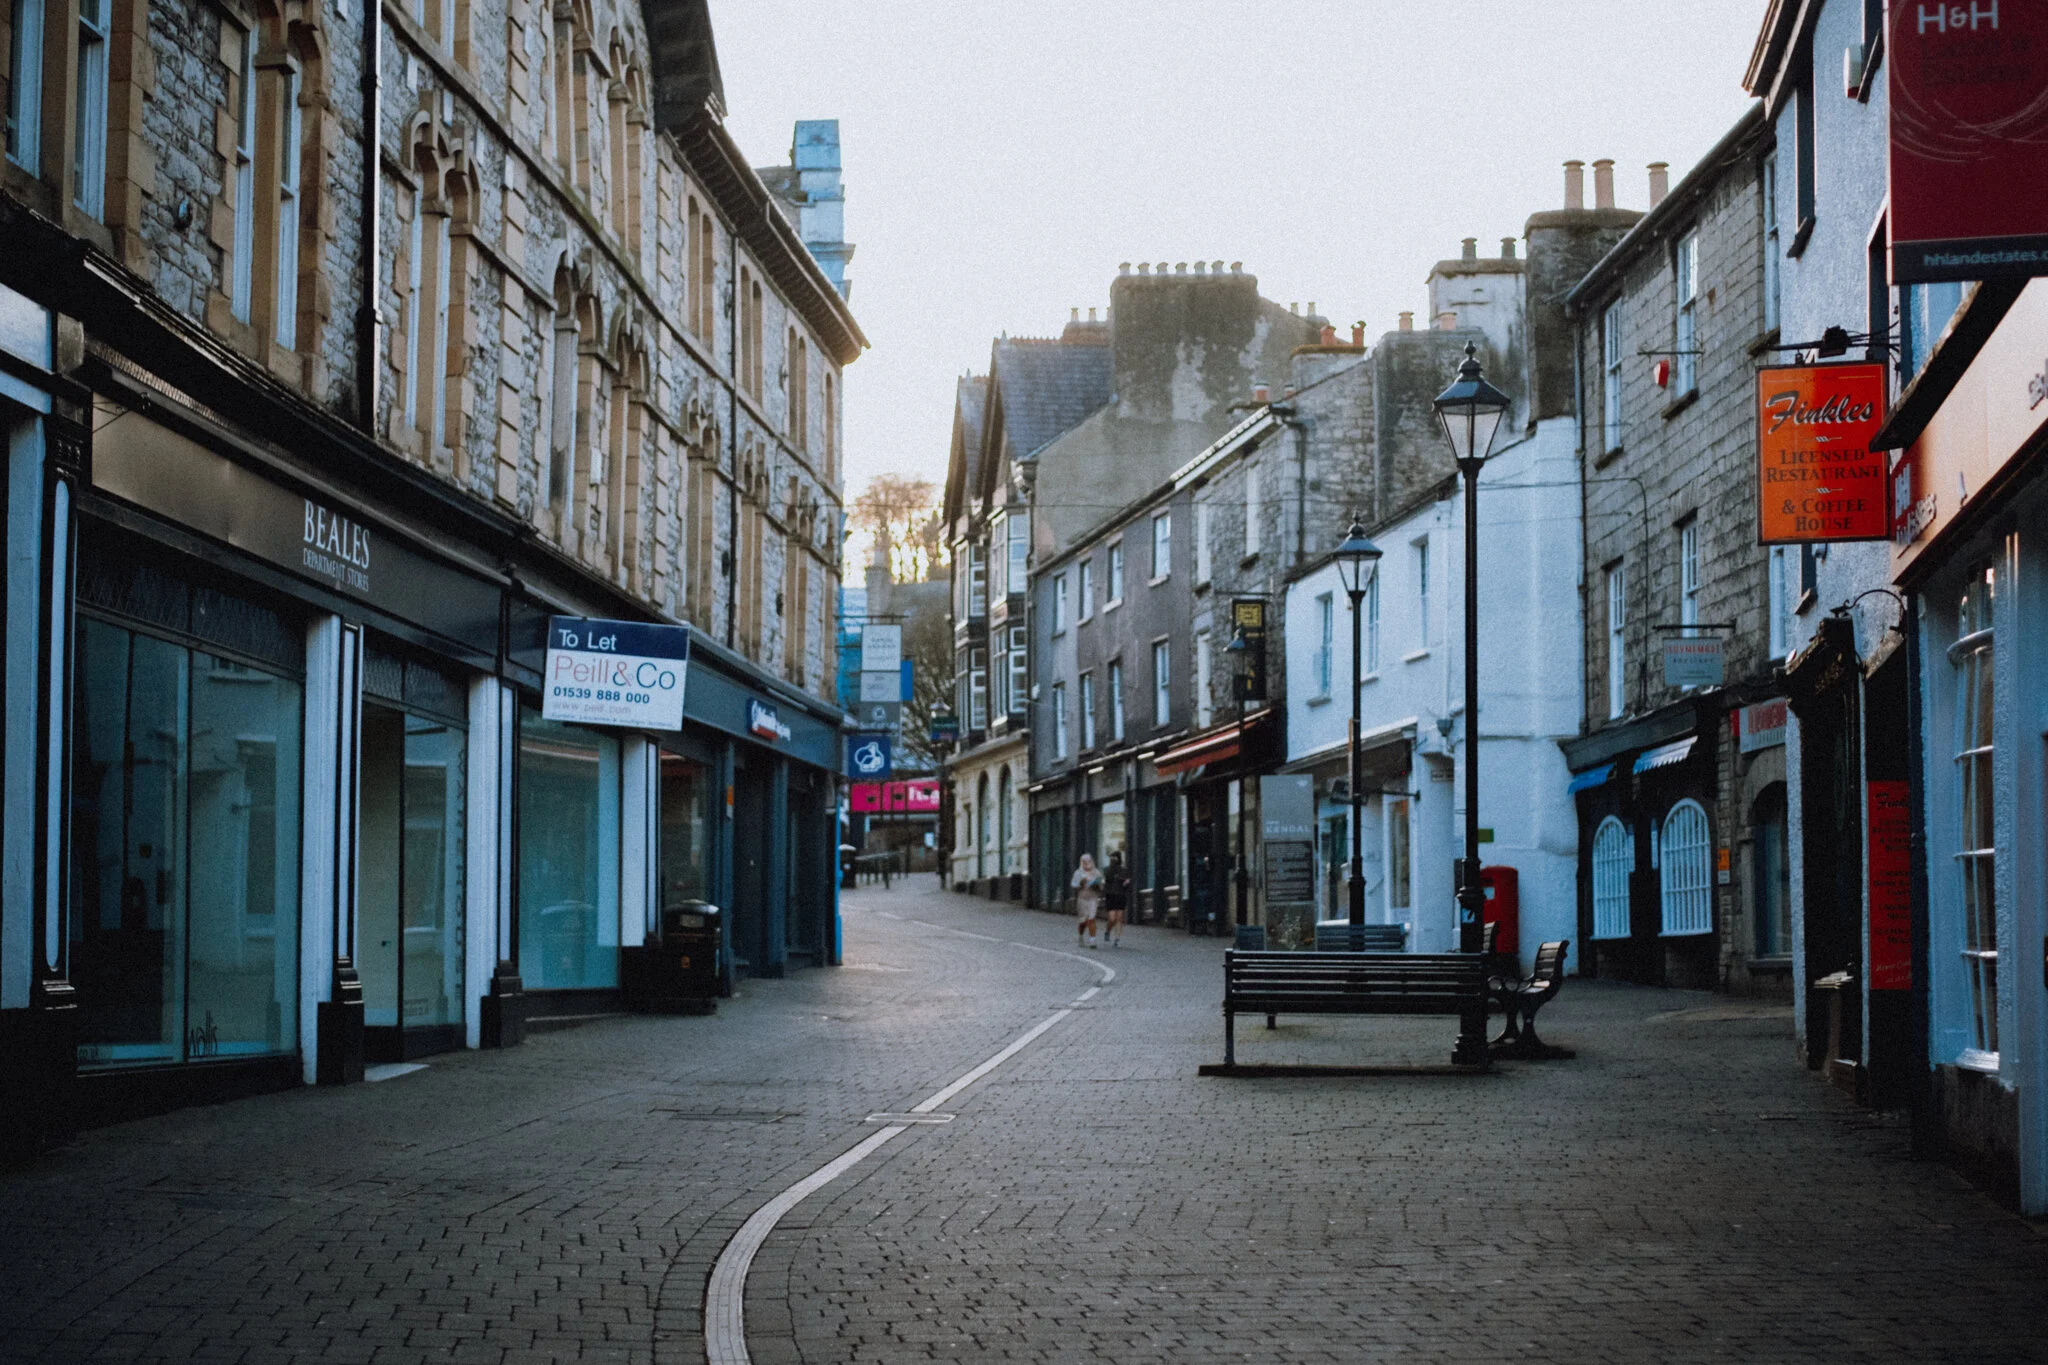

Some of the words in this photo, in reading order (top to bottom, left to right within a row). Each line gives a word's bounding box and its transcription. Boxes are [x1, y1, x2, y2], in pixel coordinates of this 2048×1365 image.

[1917, 0, 1999, 34] H&H
[1765, 389, 1874, 435] Finkles
[1780, 447, 1865, 465] LICENSED
[1766, 465, 1880, 483] RESTAURANT
[1782, 498, 1795, 515] &
[1802, 497, 1867, 514] COFFEE
[1795, 516, 1853, 532] HOUSE
[303, 498, 370, 569] BEALES
[303, 547, 346, 582] DEPARTMENT
[558, 628, 579, 648] To
[587, 631, 618, 651] Let
[553, 686, 592, 699] 01539
[596, 689, 621, 701] 888
[626, 692, 650, 704] 000
[1265, 823, 1311, 833] KENDAL
